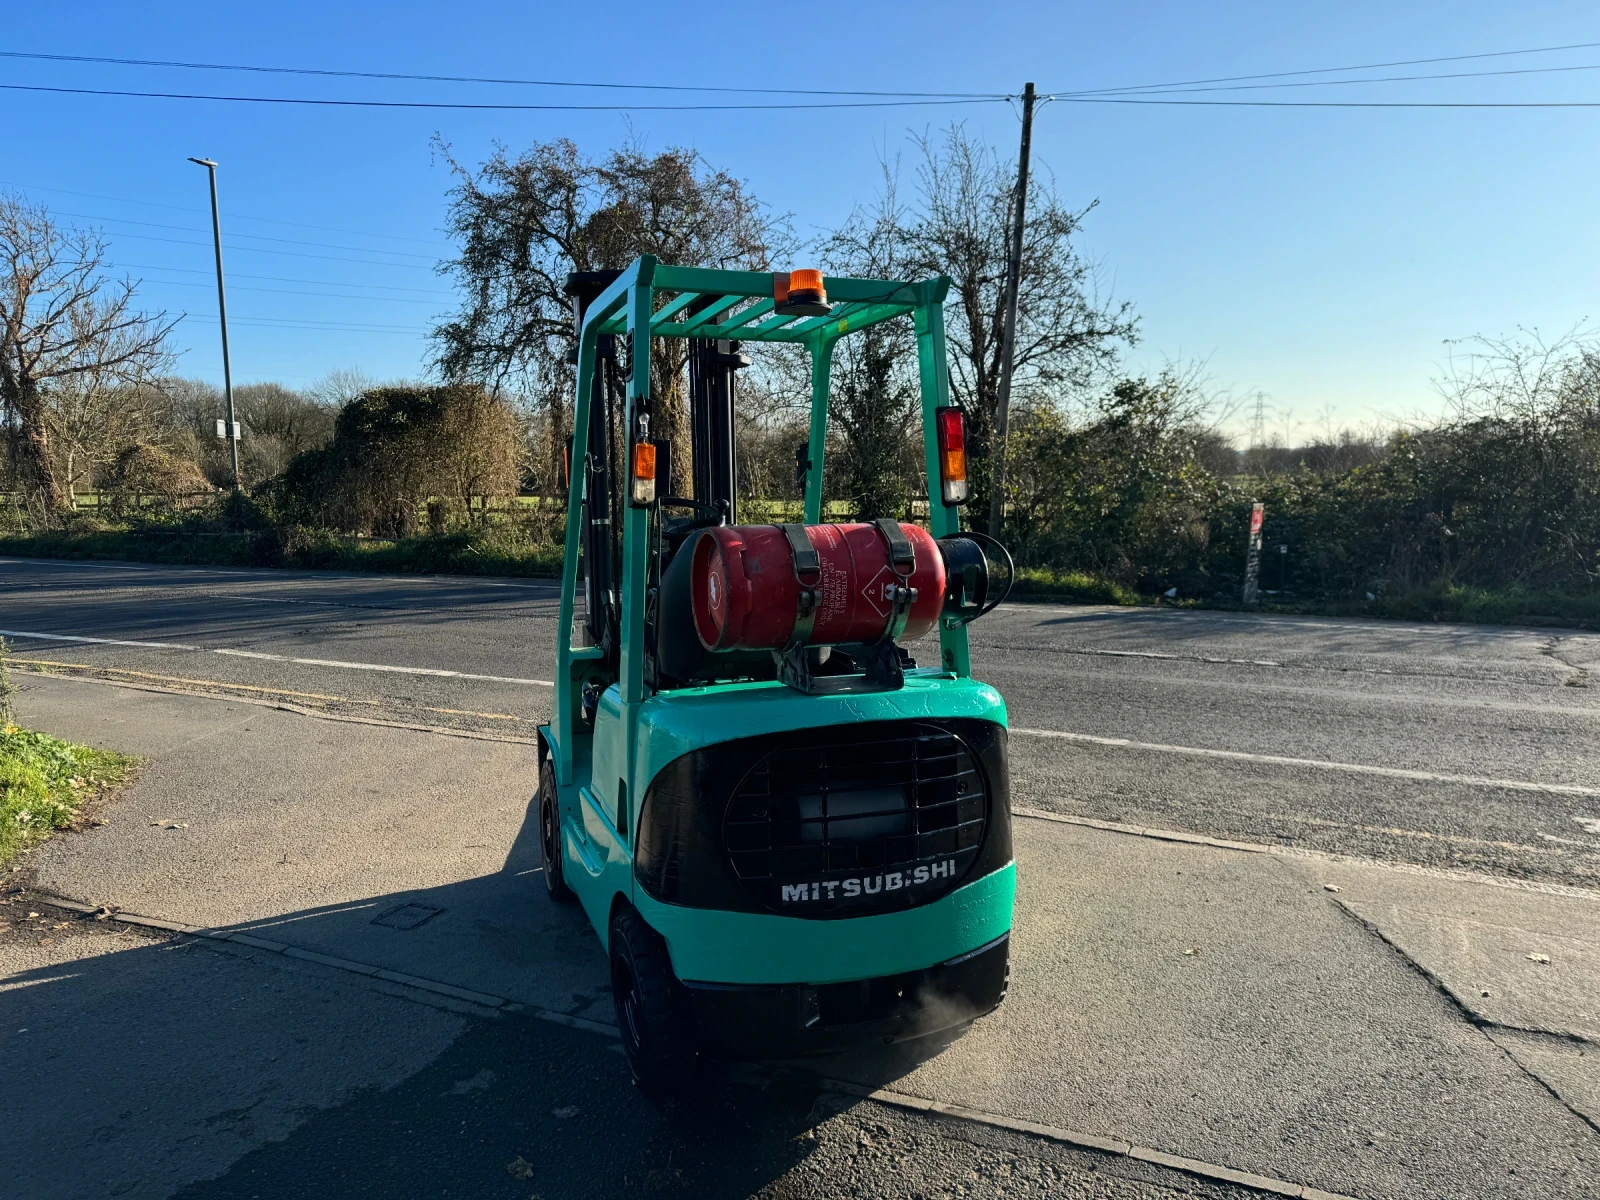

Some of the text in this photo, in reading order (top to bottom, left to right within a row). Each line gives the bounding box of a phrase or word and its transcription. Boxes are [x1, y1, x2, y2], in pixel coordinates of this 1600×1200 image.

[828, 562, 835, 574] UN
[822, 568, 830, 607] CARRIAGE
[826, 589, 835, 622] PROPANE
[834, 570, 842, 615] FLAMMABLE
[839, 570, 848, 615] EXTREMELY
[819, 607, 828, 626] ONLY
